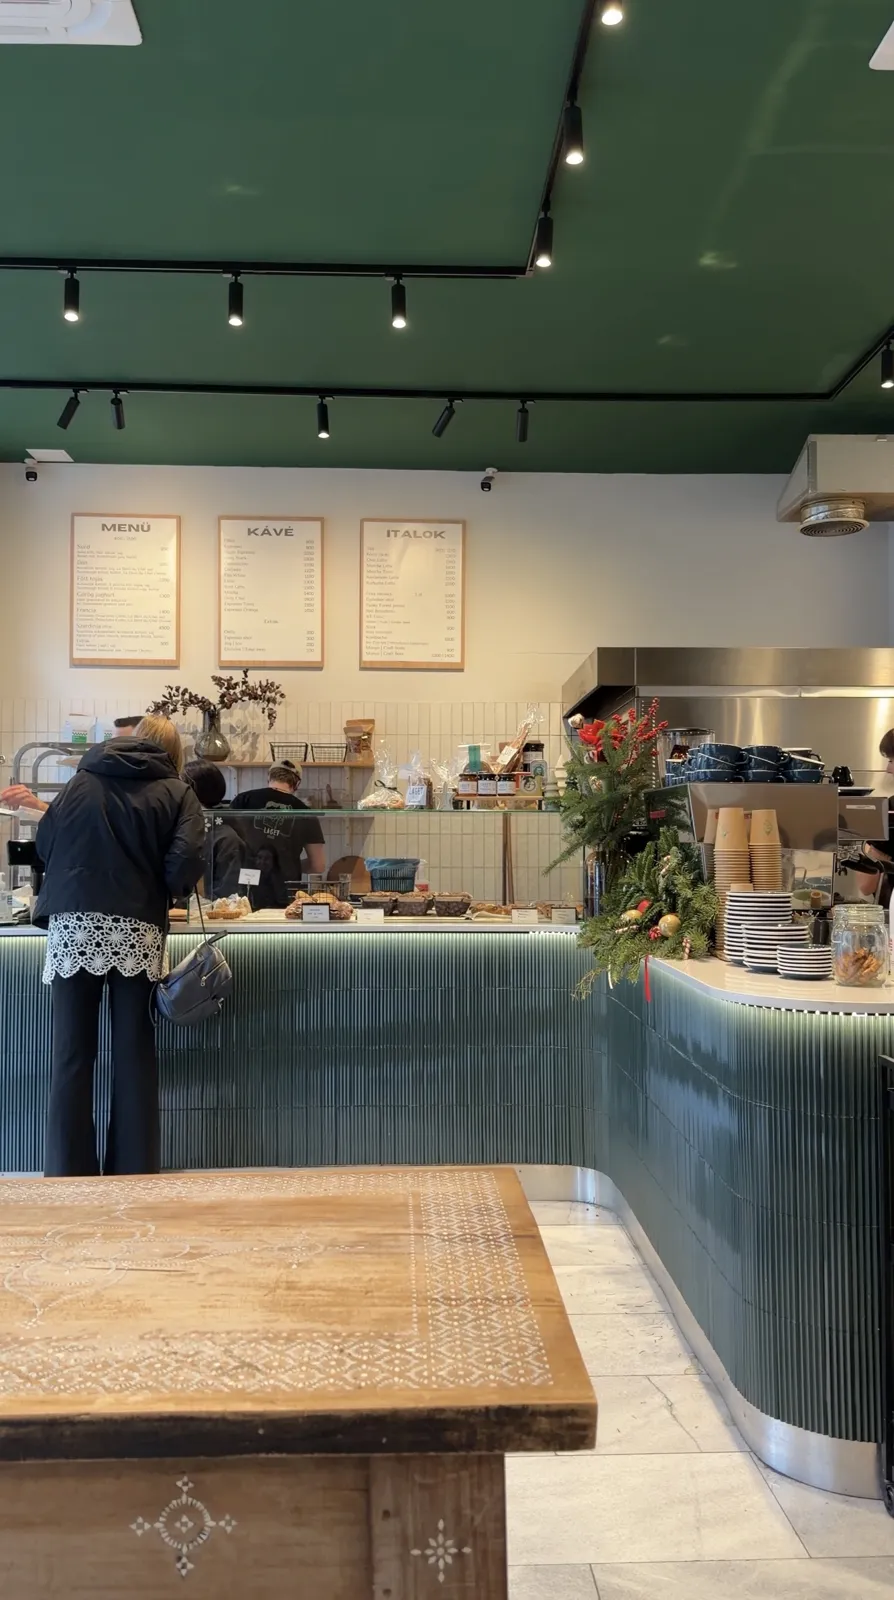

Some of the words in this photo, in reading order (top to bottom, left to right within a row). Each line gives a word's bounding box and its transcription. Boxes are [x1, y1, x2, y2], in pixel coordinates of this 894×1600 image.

[101, 522, 151, 532] MENÜ
[247, 525, 295, 536] KÁVÉ
[386, 529, 446, 539] ITALOK
[263, 826, 281, 836] LAGET
